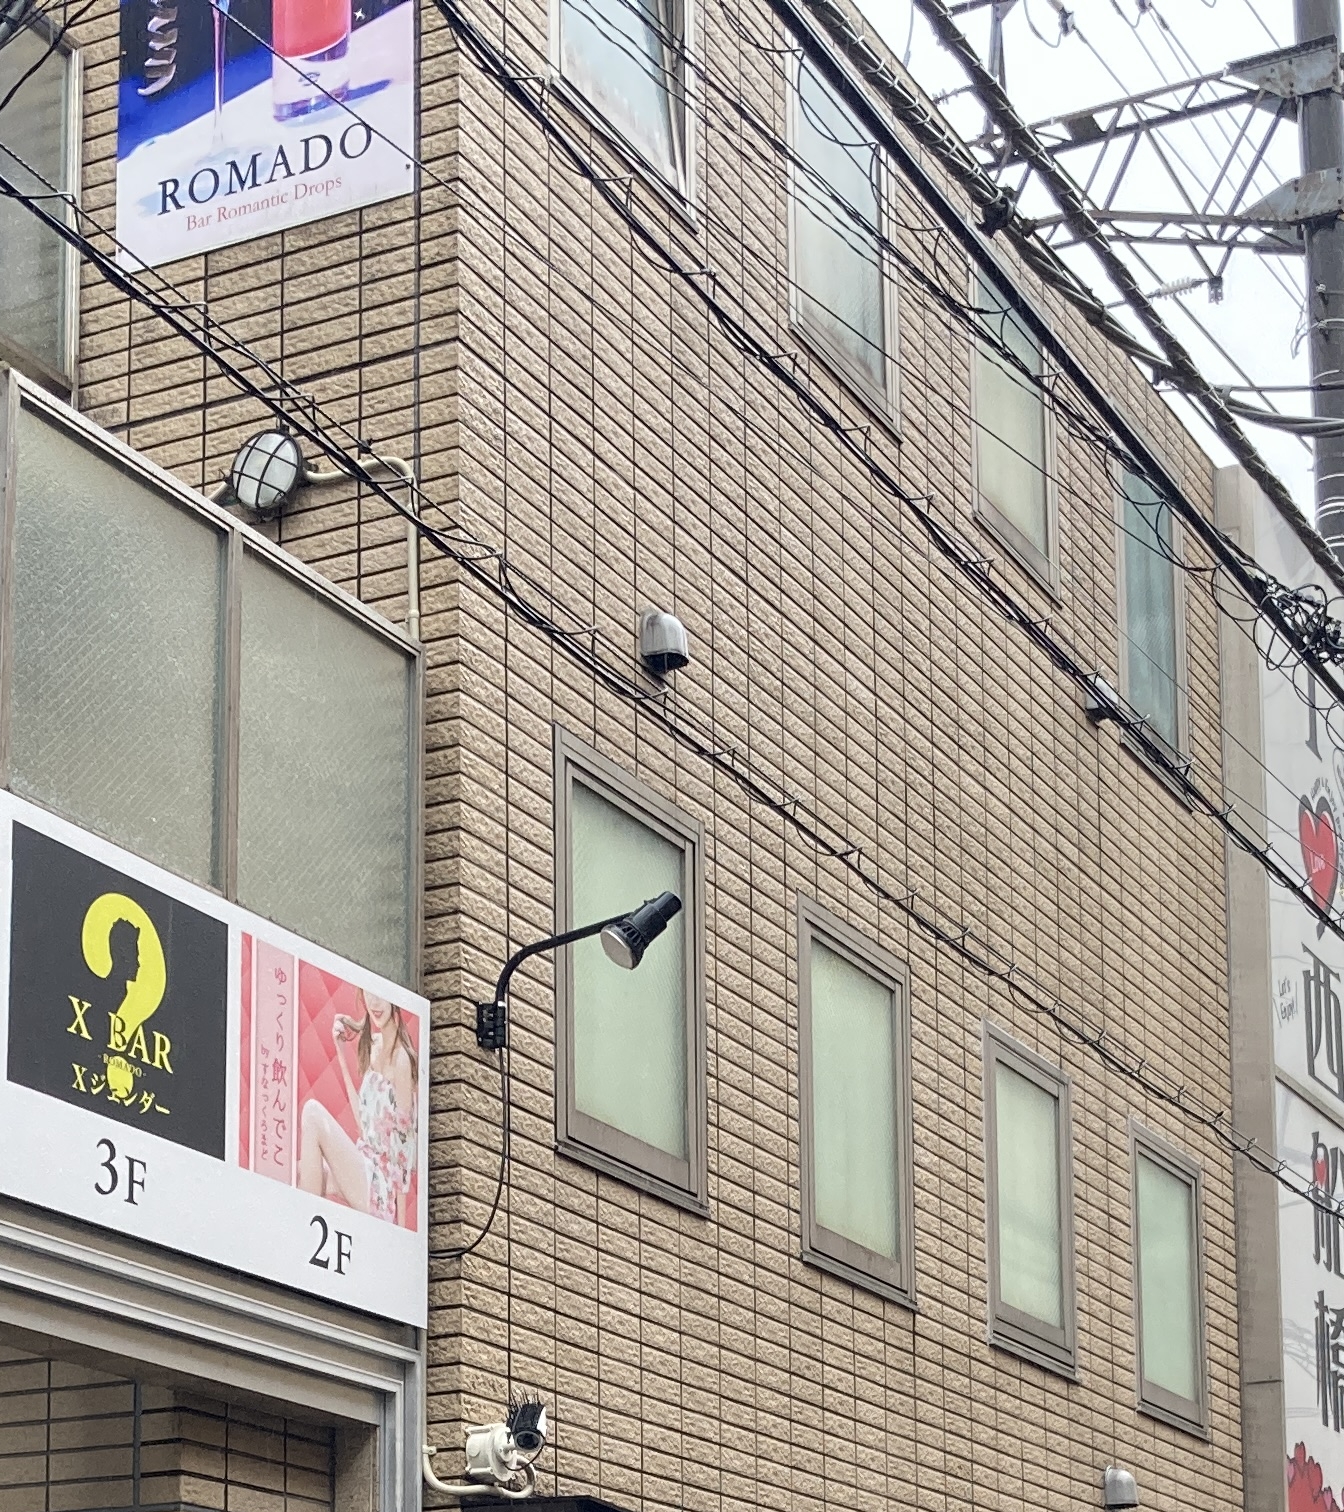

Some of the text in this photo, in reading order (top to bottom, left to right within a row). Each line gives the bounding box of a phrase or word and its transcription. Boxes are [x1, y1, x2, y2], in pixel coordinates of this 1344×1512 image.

[157, 122, 373, 216] ROMADO
[186, 175, 343, 232] Bar Romantic Drops
[67, 995, 173, 1074] X BAR
[271, 967, 288, 1168] ゆっくり飲んでこ
[72, 1062, 171, 1115] Xジェンダー
[94, 1137, 148, 1206] 3F
[308, 1215, 354, 1276] 2F
